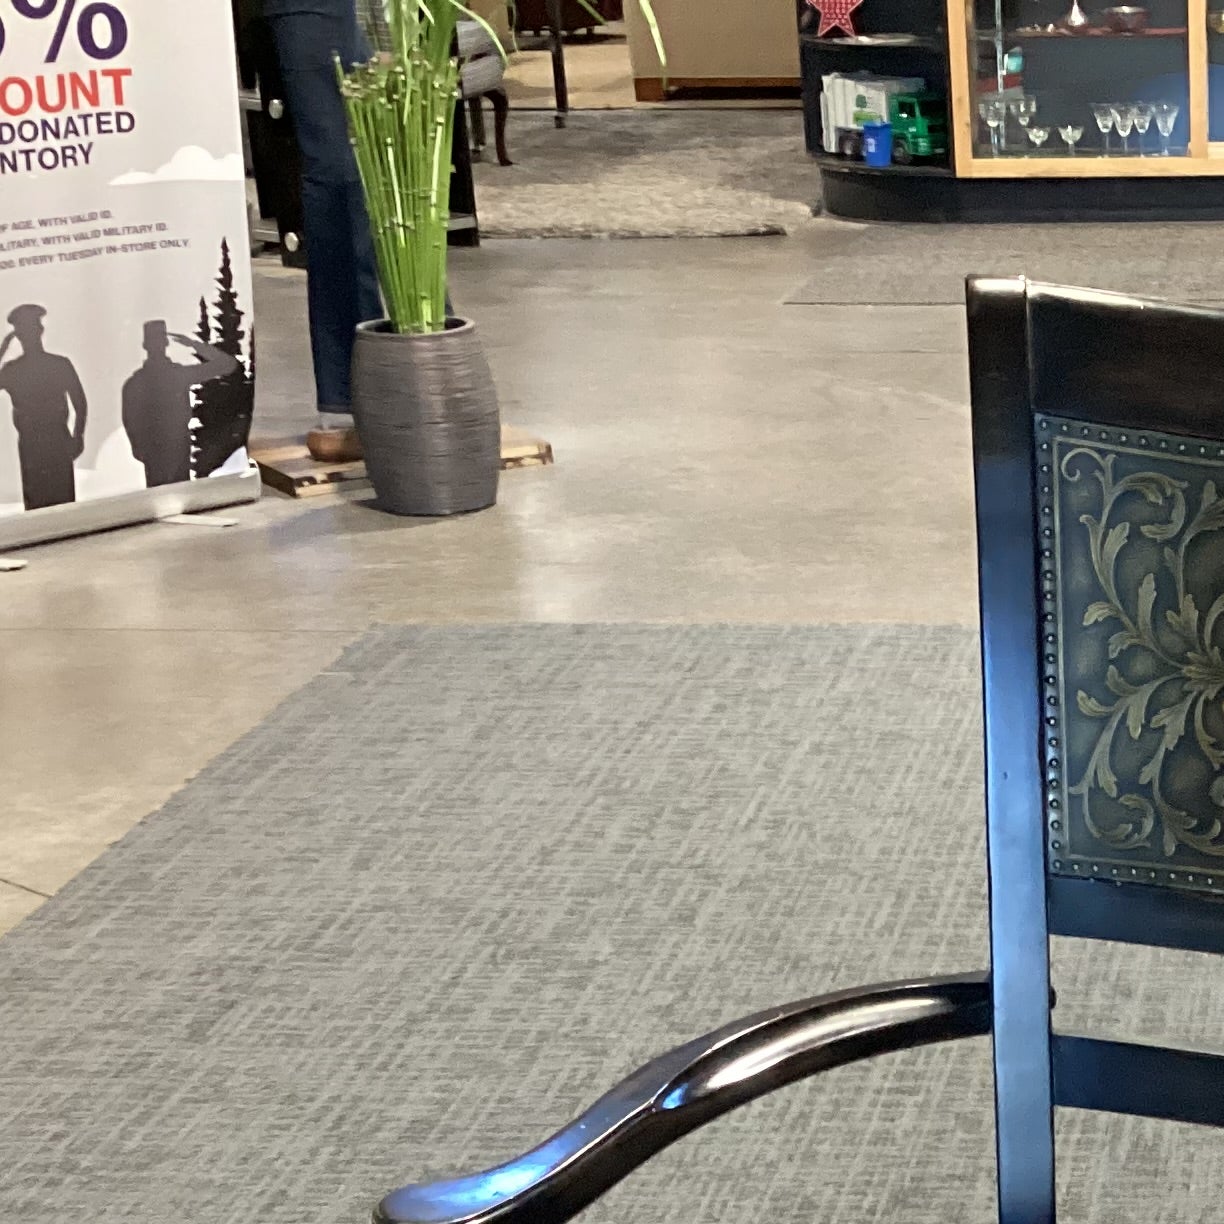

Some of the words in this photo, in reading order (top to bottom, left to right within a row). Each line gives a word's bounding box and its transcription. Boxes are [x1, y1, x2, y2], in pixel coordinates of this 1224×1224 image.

[0, 111, 135, 145] DONATED
[0, 142, 93, 174] NTORY
[38, 216, 67, 227] WITH
[69, 211, 98, 224] VALID
[41, 234, 70, 245] WITH
[73, 229, 100, 242] VALID
[103, 223, 153, 237] MILITARY
[18, 254, 53, 267] EVERY
[58, 246, 104, 262] TUESDAY
[106, 240, 157, 254] IN-STORE
